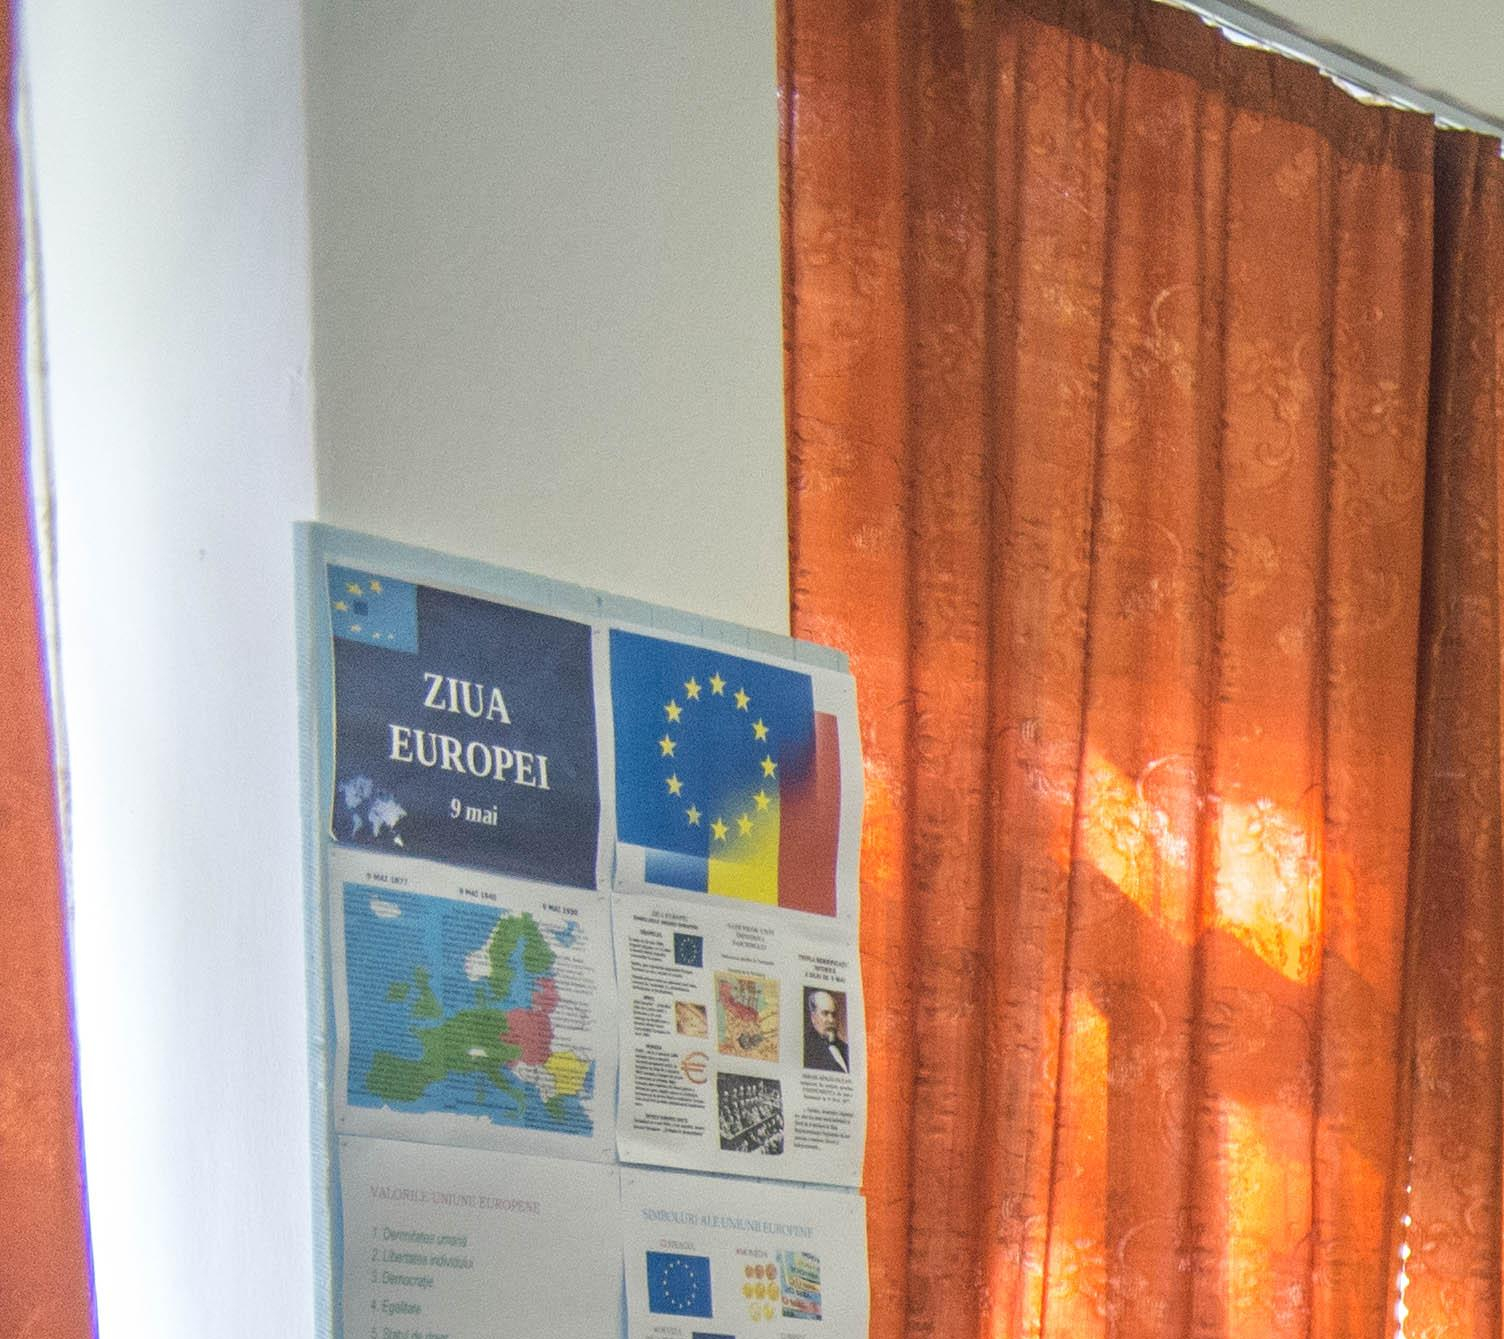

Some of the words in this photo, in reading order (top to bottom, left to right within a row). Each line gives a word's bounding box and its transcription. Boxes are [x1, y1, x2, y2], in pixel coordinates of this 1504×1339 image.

[423, 672, 511, 724] ZIUA
[388, 724, 551, 790] EUROPEI
[450, 797, 461, 820] 9
[465, 801, 498, 827] mai
